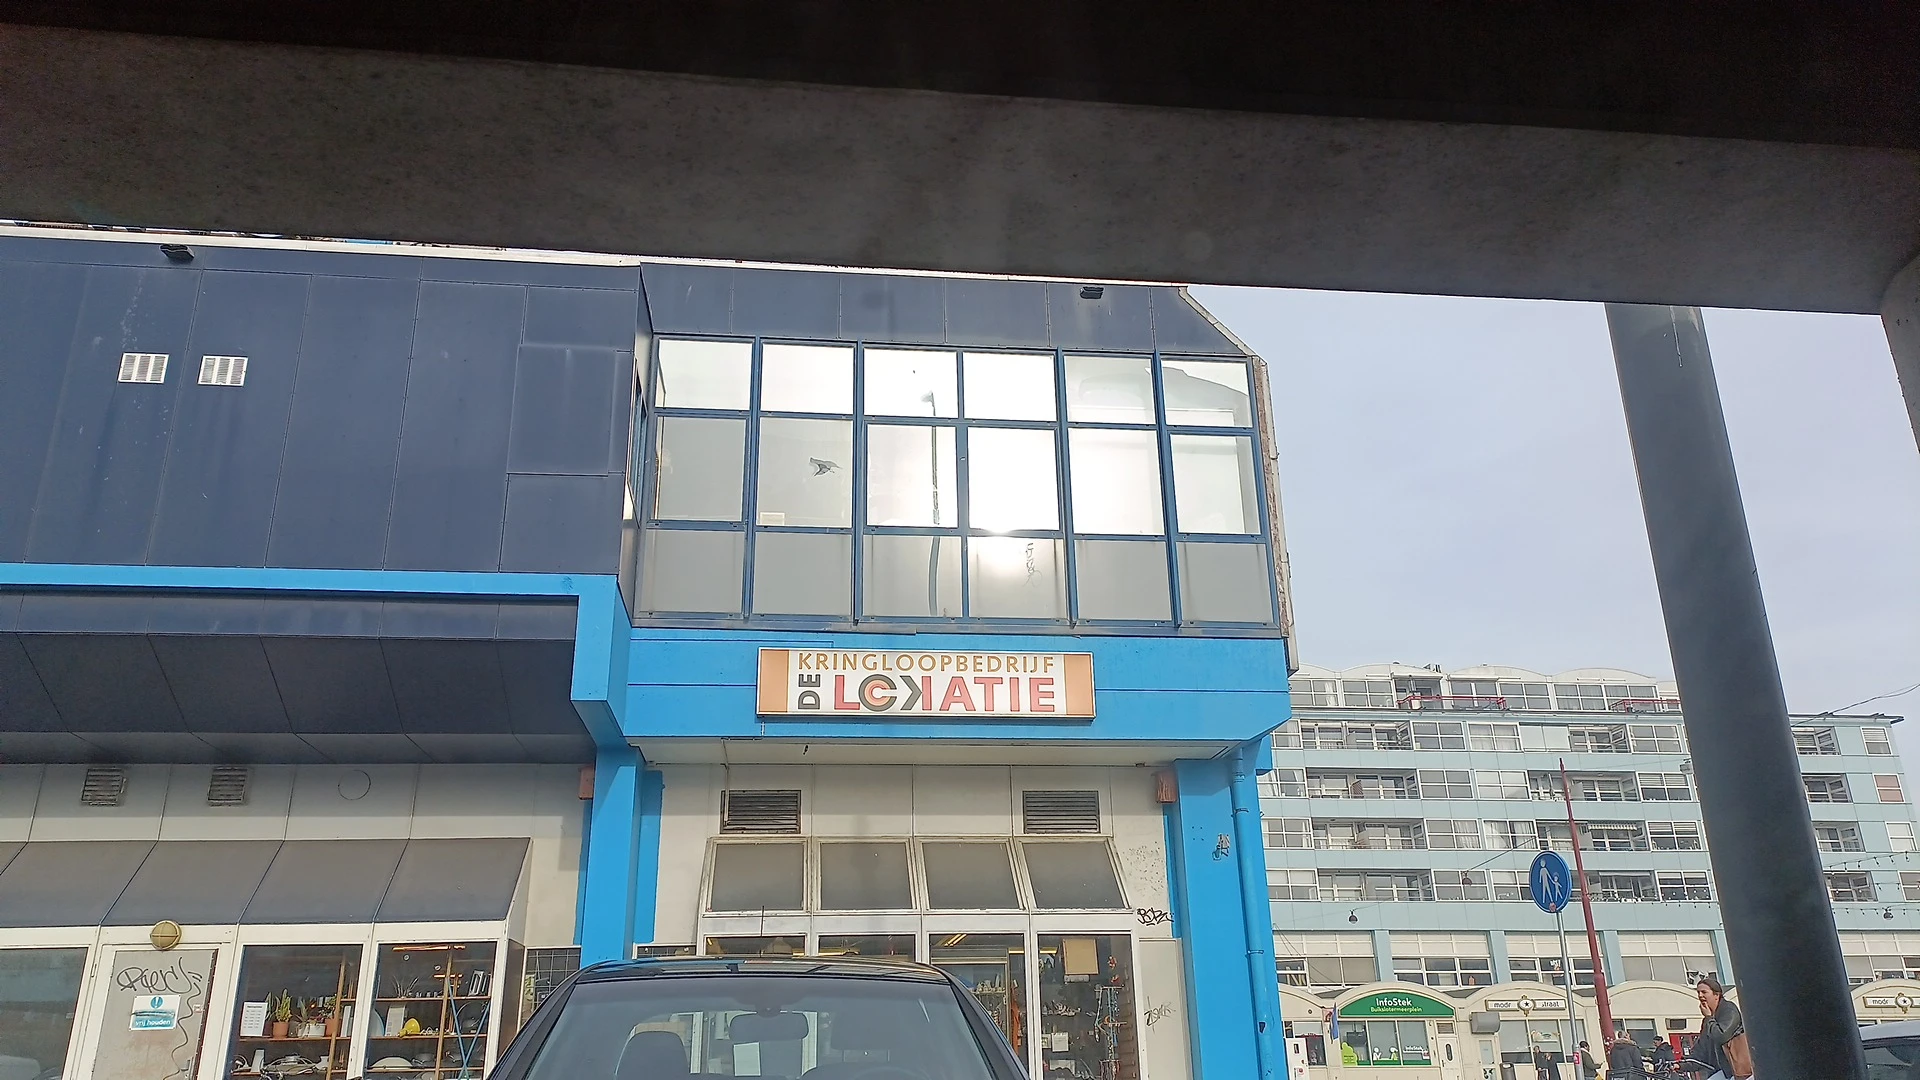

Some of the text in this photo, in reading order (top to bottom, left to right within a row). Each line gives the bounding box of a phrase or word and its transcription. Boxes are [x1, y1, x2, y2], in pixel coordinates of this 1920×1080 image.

[798, 652, 1054, 674] KRINGLOOPBEDRIJF
[797, 673, 821, 710] DE
[1375, 997, 1413, 1006] InfoStek
